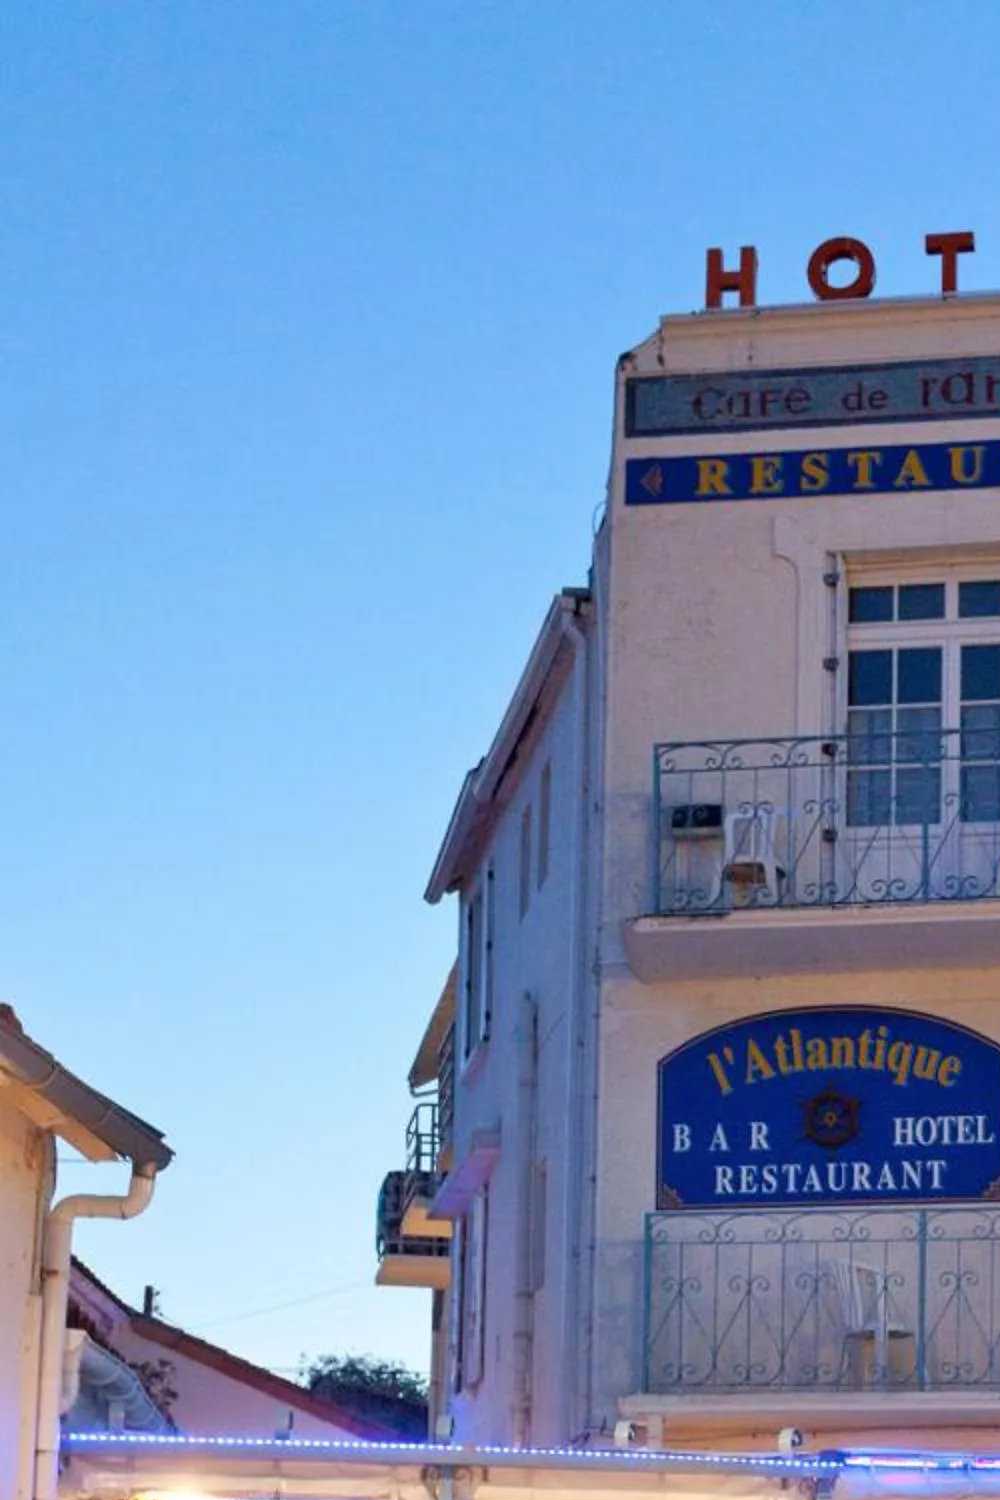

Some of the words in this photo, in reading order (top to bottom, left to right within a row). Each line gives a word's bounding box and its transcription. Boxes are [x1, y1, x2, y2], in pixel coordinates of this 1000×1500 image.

[841, 382, 890, 412] de
[706, 1025, 962, 1098] l'Atlantique
[893, 1115, 995, 1147] HOTEL
[714, 1160, 946, 1195] RESTAURANT
